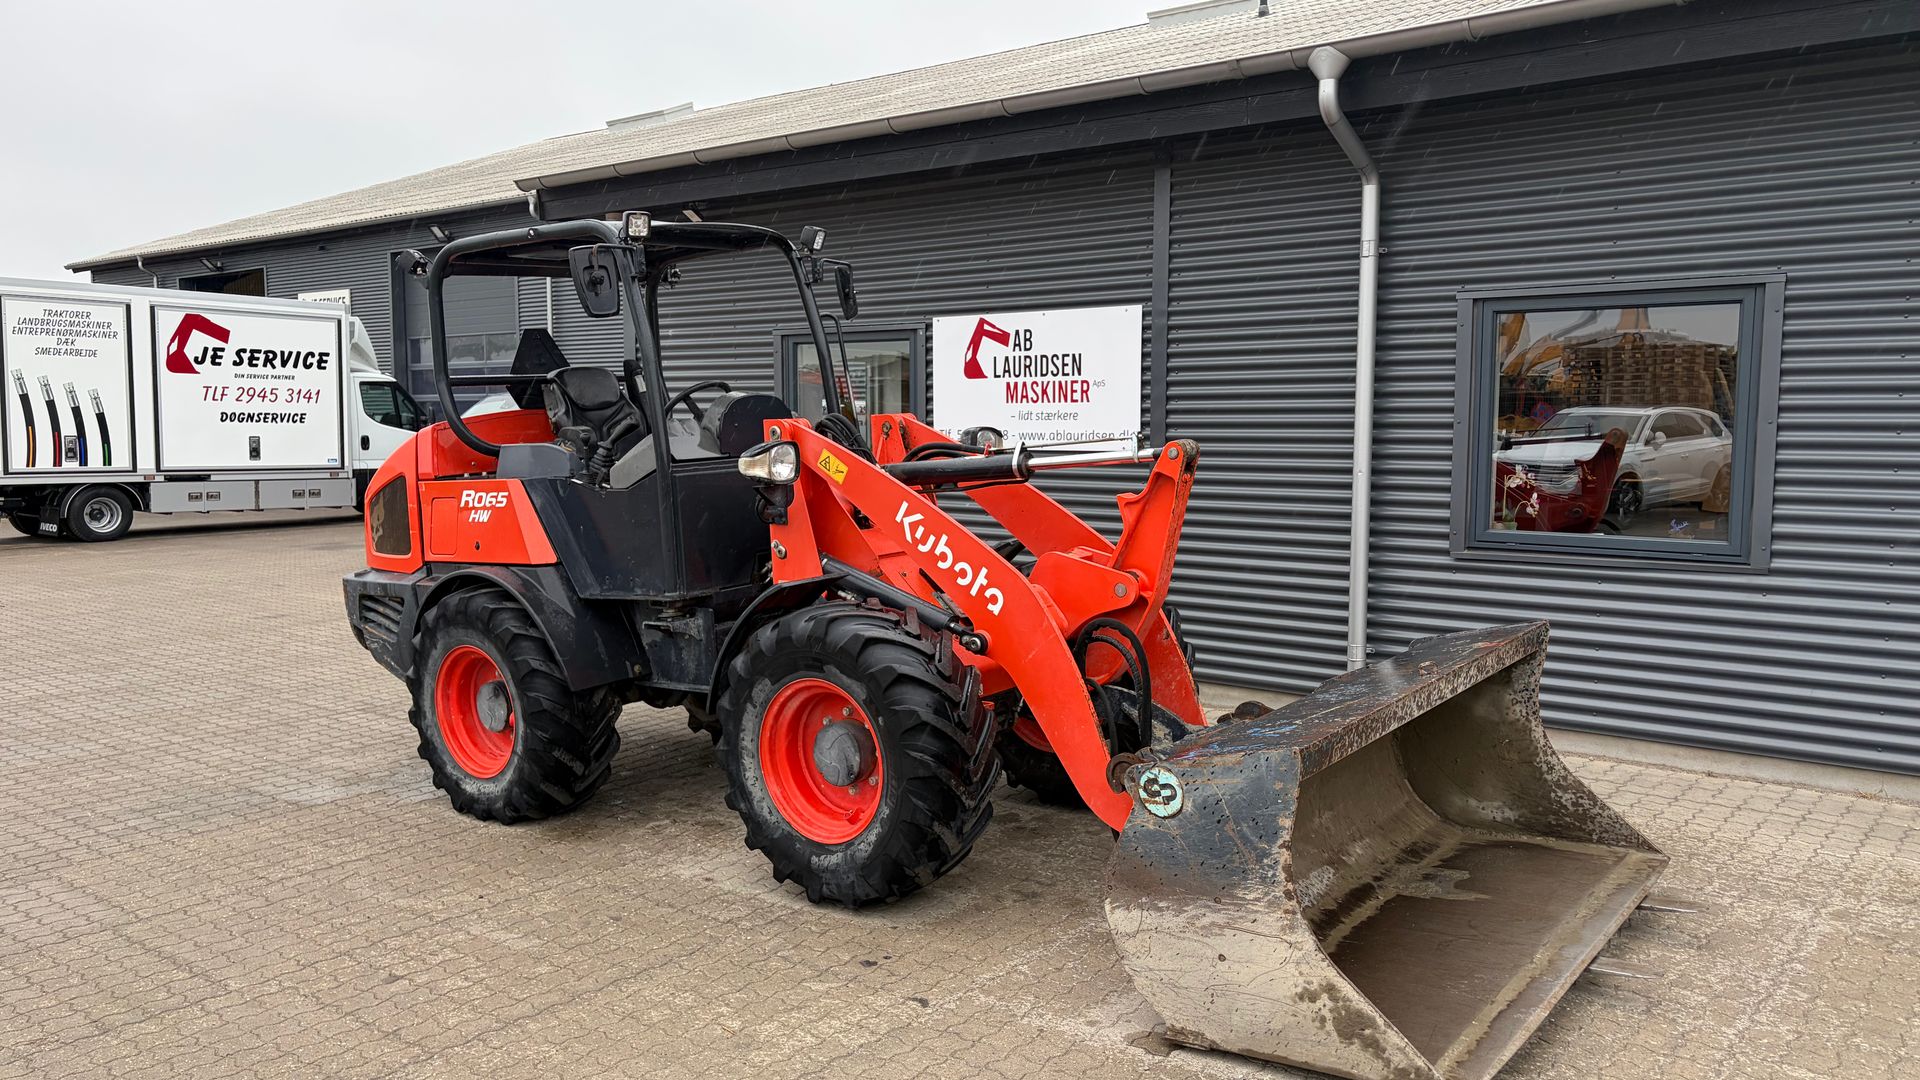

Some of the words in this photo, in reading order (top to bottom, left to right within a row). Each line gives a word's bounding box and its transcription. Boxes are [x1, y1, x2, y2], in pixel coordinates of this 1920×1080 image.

[42, 308, 92, 320] TRAKTORER
[17, 317, 113, 330] LANDBRUGSMASKINER
[12, 326, 119, 339] ENTREPRENØRMASKINER
[56, 337, 77, 346] DÆK
[1012, 328, 1033, 352] AB
[34, 347, 98, 357] SMEDEARBEJDE
[193, 346, 226, 366] JE
[232, 348, 331, 370] SERVICE
[993, 353, 1082, 378] LAURIDSEN
[203, 385, 230, 401] TLF
[235, 386, 279, 404] 2945
[285, 387, 321, 404] 3141
[1006, 379, 1090, 404] MASKINER
[1092, 379, 1106, 388] ApS
[219, 411, 307, 424] DØGNSERVICE
[1018, 410, 1033, 421] lidt
[1035, 410, 1079, 421] stærkere
[468, 509, 492, 523] HW
[40, 522, 58, 533] IVECO
[895, 500, 1004, 616] Kubota
